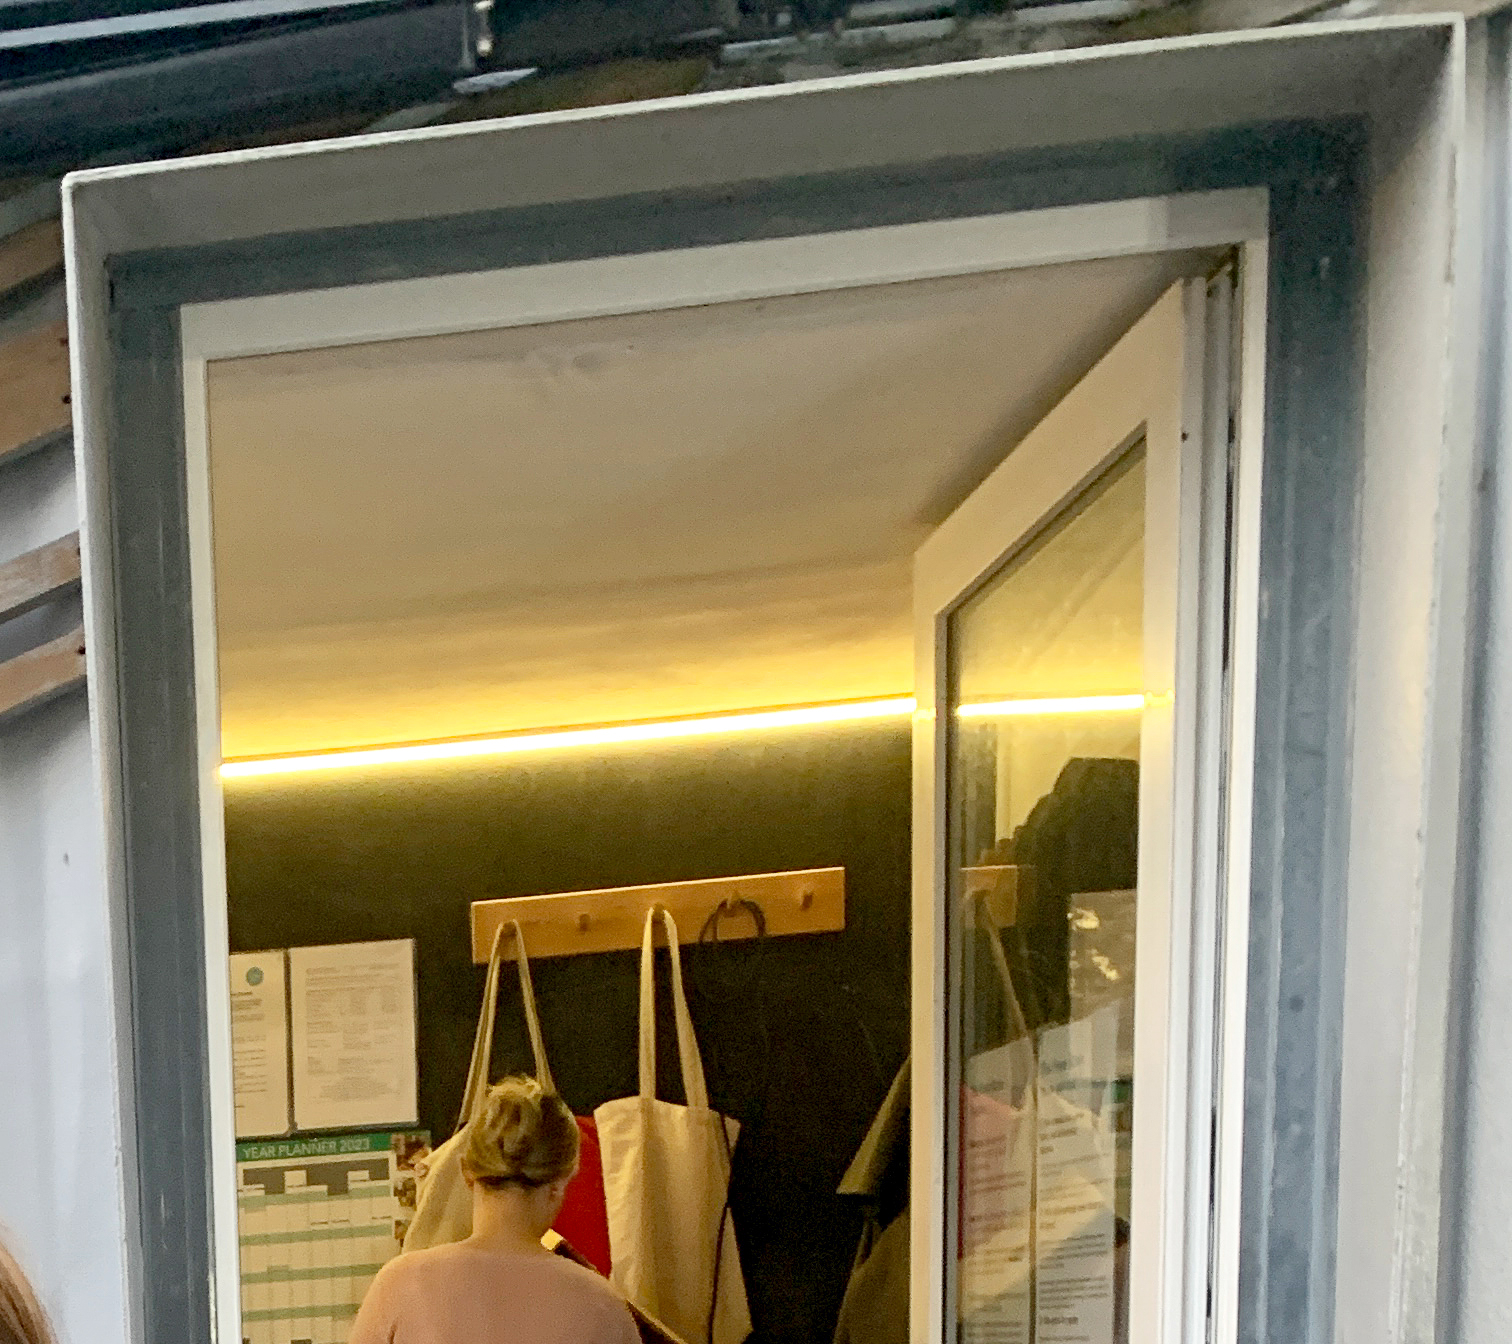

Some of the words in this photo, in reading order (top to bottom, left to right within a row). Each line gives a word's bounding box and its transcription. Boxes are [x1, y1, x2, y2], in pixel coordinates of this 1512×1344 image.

[243, 1145, 276, 1160] YEAR
[278, 1140, 337, 1157] PLANNER
[339, 1137, 370, 1152] 2023
